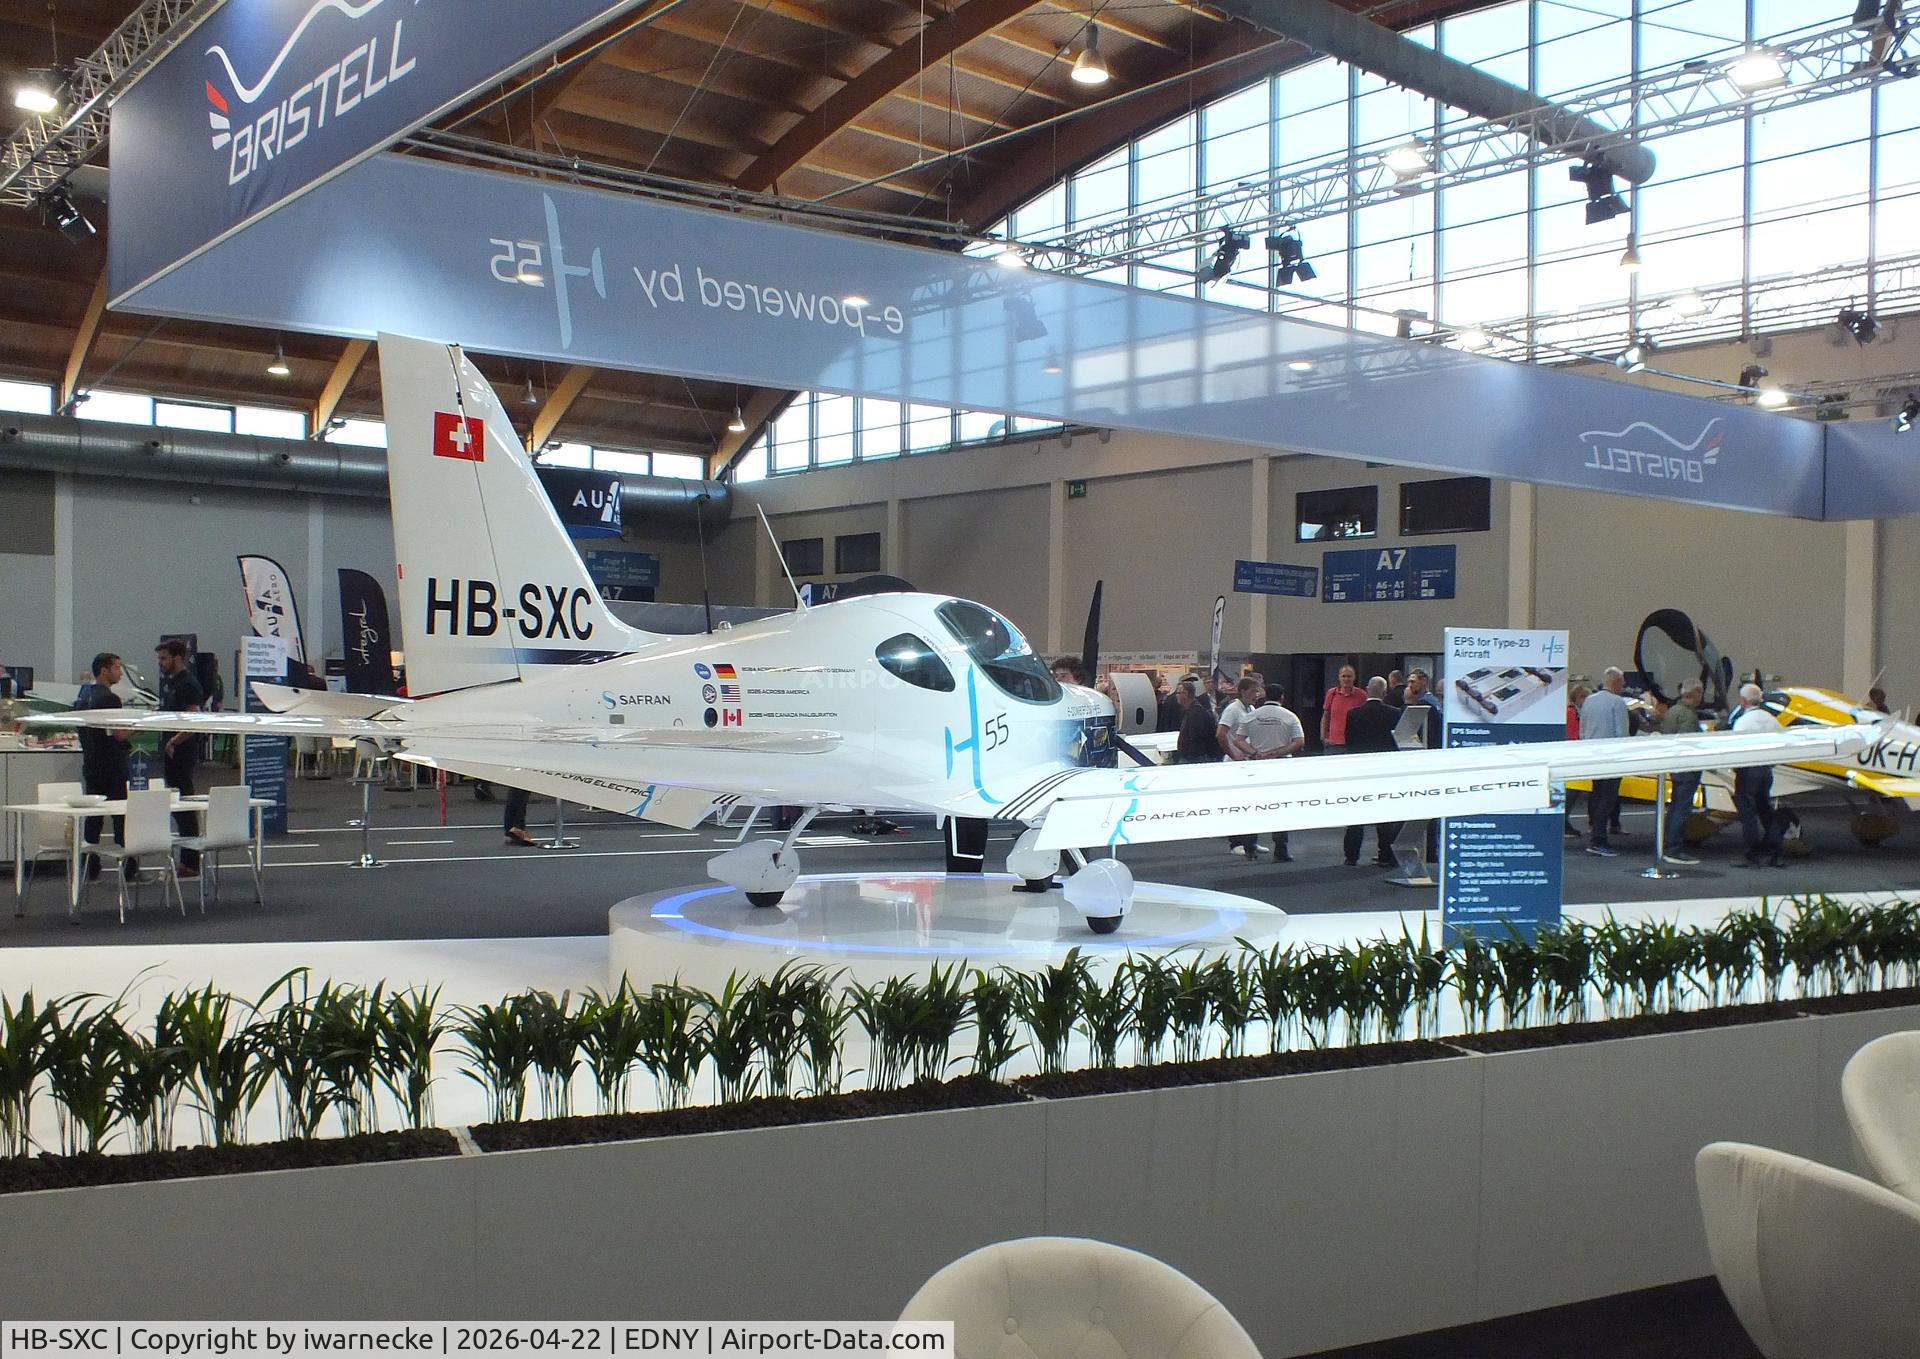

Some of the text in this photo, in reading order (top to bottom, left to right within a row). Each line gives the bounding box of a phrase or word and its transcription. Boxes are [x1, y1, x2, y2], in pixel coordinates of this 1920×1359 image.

[228, 19, 417, 186] BRISTELL
[1376, 549, 1407, 571] A7
[601, 586, 623, 600] A7
[822, 584, 838, 600] A7
[426, 577, 593, 641] HB-SXC
[1454, 636, 1475, 646] EPS
[1477, 637, 1490, 647] for
[1492, 638, 1530, 650] Type-23
[1454, 649, 1490, 659] Aircraft
[619, 694, 671, 706] SAFRAN
[593, 779, 652, 798] ELECTRIC
[1123, 814, 1147, 823] GO
[1217, 805, 1252, 814] TRY
[1255, 801, 1293, 811] NOT
[1297, 799, 1321, 807] TO
[1325, 794, 1374, 805] LOVE
[1377, 788, 1441, 801] FLYING
